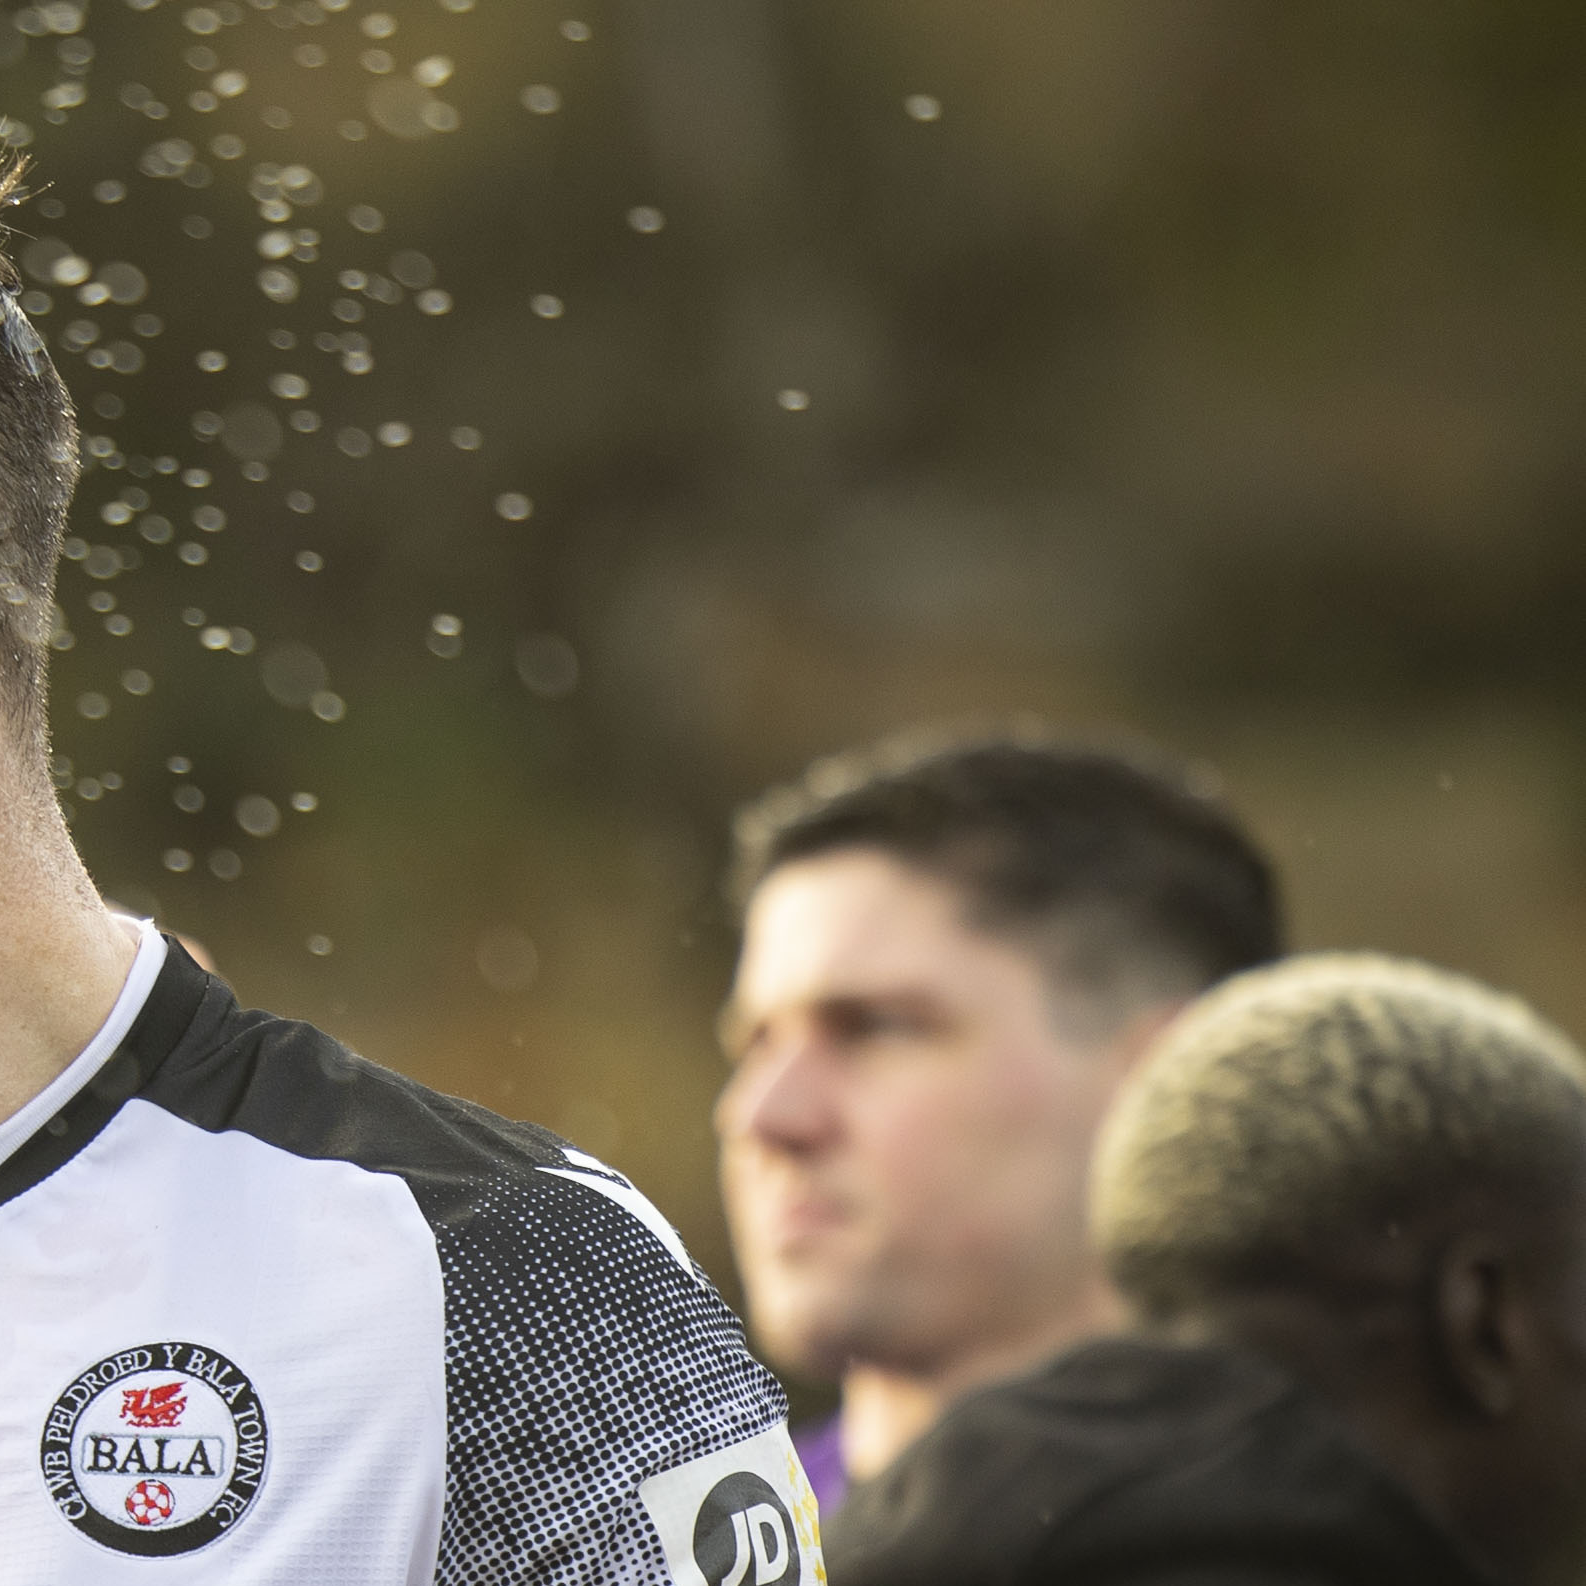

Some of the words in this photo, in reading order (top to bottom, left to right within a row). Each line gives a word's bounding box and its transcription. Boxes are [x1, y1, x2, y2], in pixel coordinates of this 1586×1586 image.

[163, 1344, 183, 1369] Y
[186, 1347, 247, 1405] BALA
[46, 1348, 153, 1444] PELDROED
[87, 1435, 216, 1476] BALA
[233, 1401, 265, 1487] TOWN
[43, 1449, 88, 1522] CLWB
[209, 1488, 249, 1528] FC
